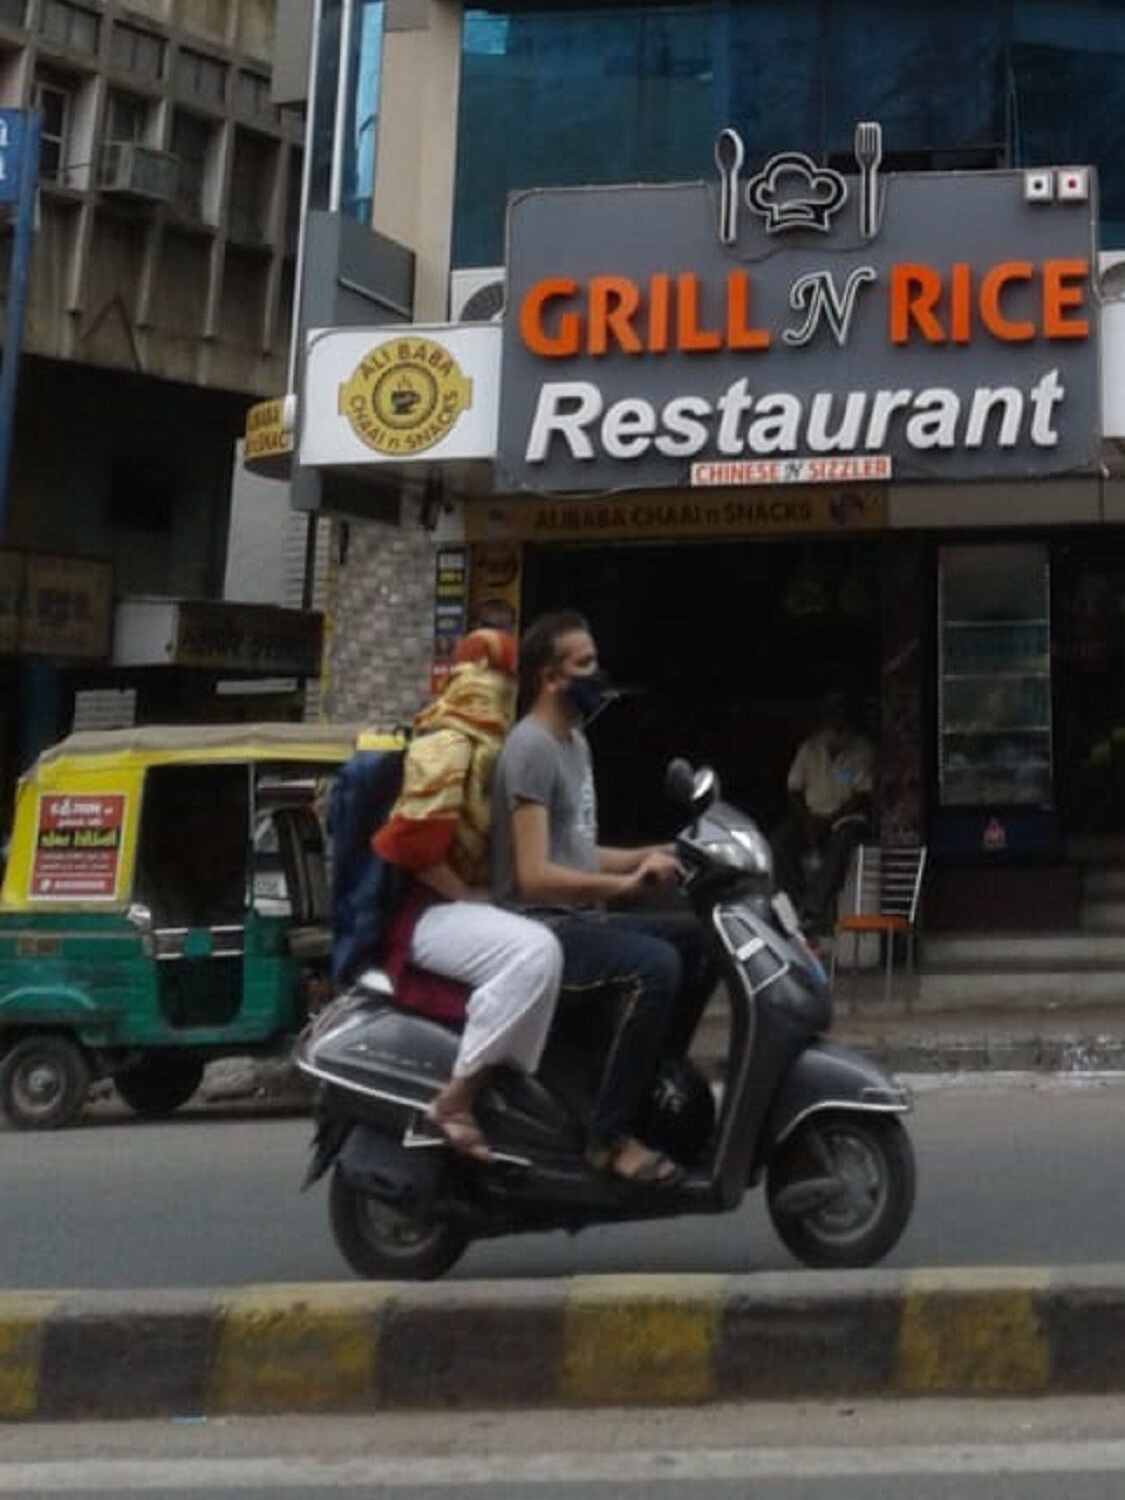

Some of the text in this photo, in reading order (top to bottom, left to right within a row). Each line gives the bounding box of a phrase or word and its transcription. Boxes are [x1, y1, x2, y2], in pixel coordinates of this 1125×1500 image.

[519, 258, 1090, 357] GRILL N RICE
[361, 343, 454, 380] ALI BABA
[351, 395, 386, 447] CHAAI
[403, 391, 458, 449] SNACKS
[524, 368, 1064, 462] Restaurant
[695, 463, 777, 482] CHINESE
[808, 457, 888, 479] SIZZLER
[535, 506, 628, 529] ALIBABA
[631, 503, 701, 526] CHAAI
[724, 500, 812, 522] SNACKS
